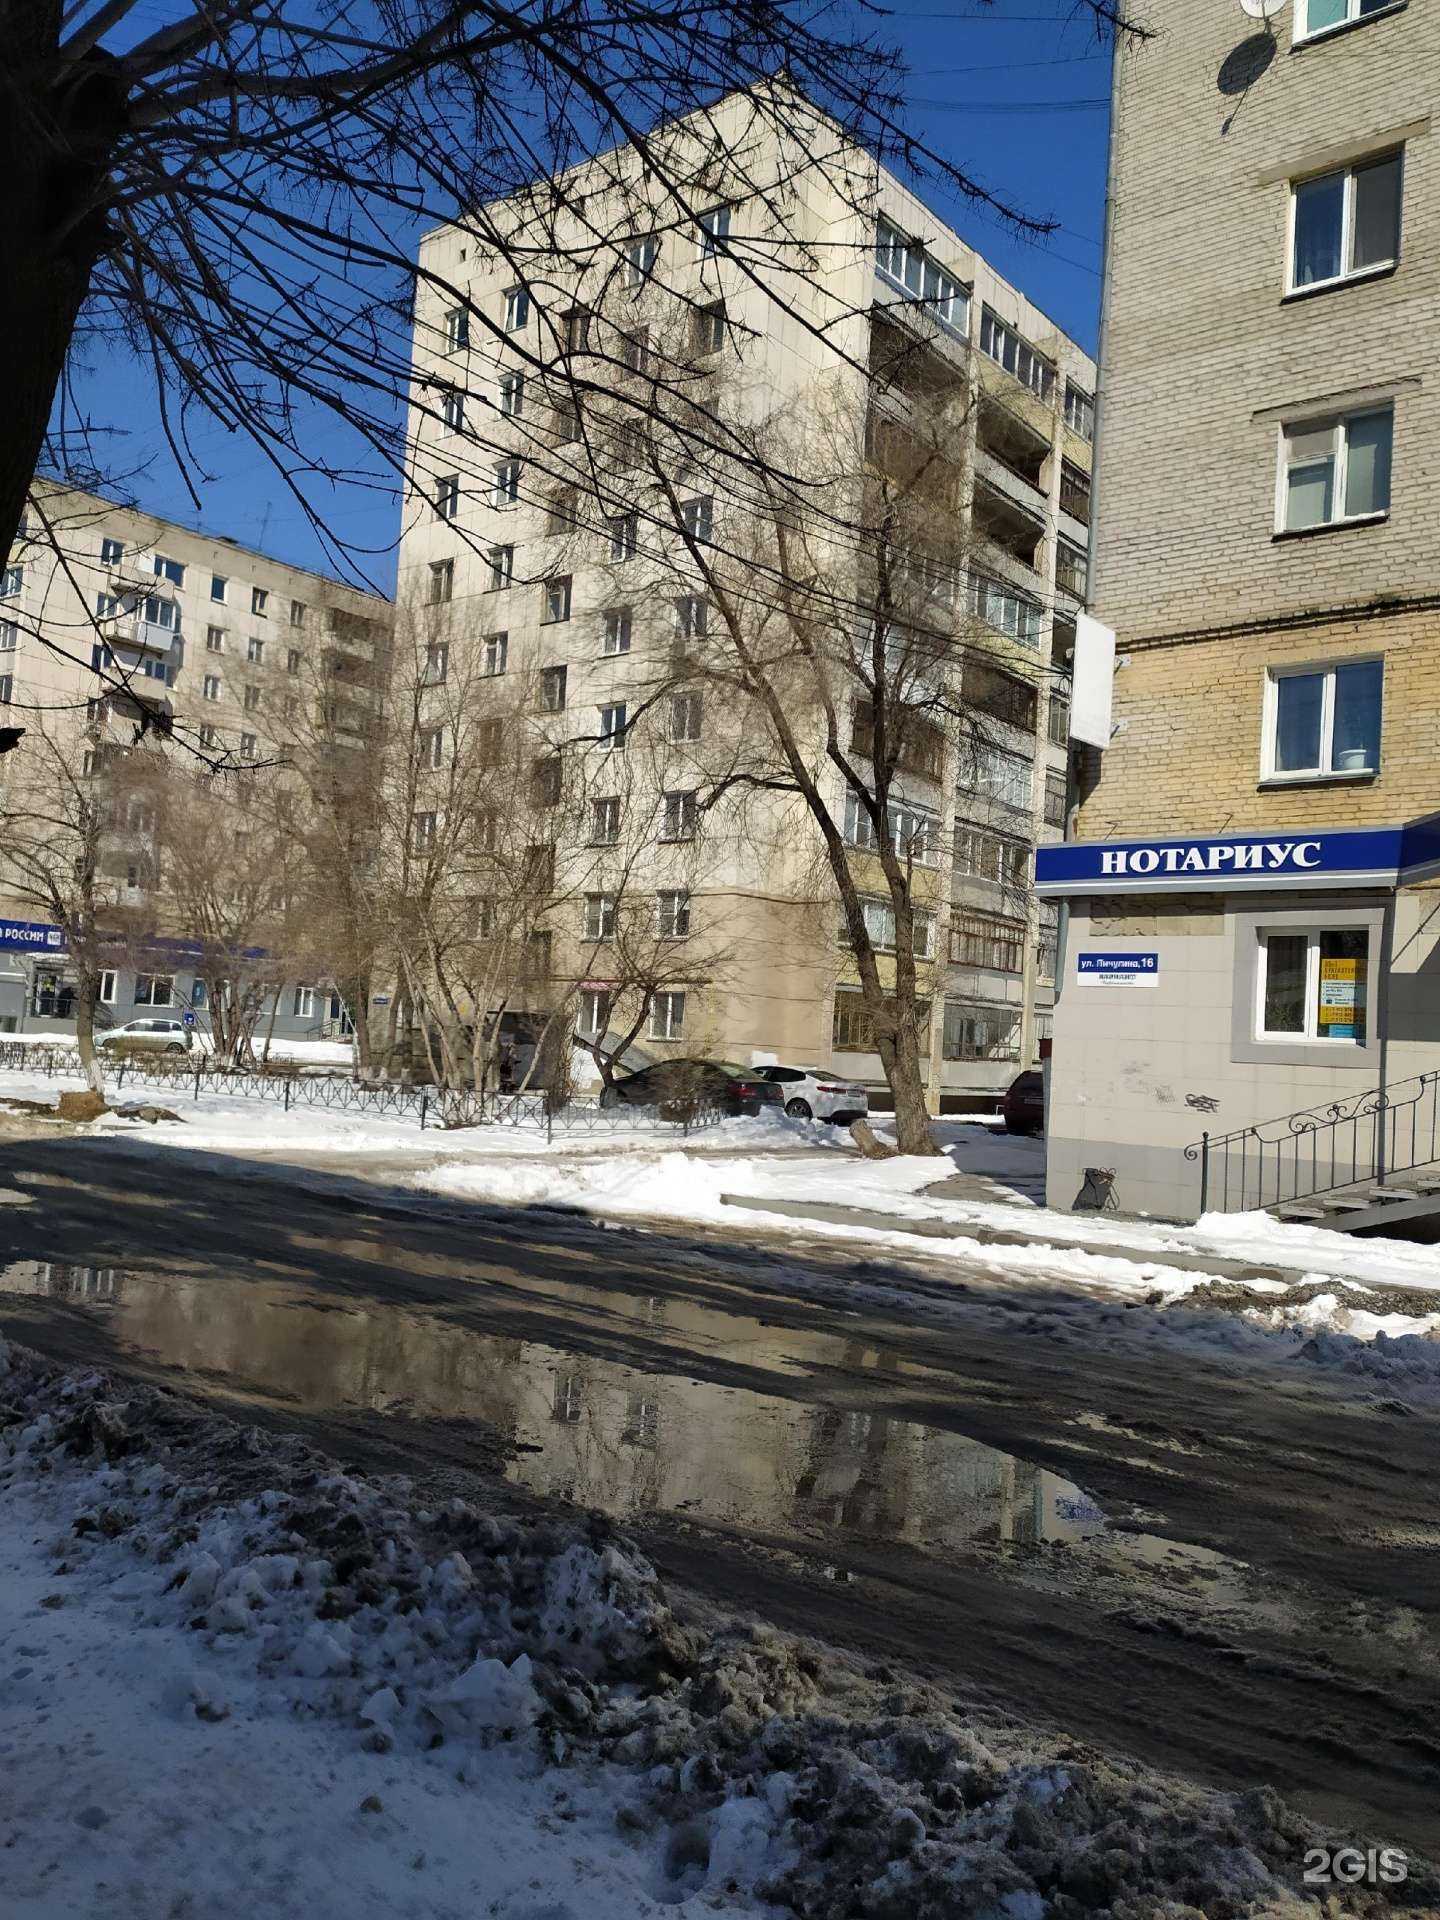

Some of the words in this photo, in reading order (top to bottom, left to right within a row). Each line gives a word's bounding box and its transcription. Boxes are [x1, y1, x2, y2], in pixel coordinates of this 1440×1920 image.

[1101, 842, 1321, 874] НОТАРИУС
[5, 928, 44, 942] РОССИИ
[1081, 960, 1094, 969] ул.
[1141, 957, 1154, 968] 16
